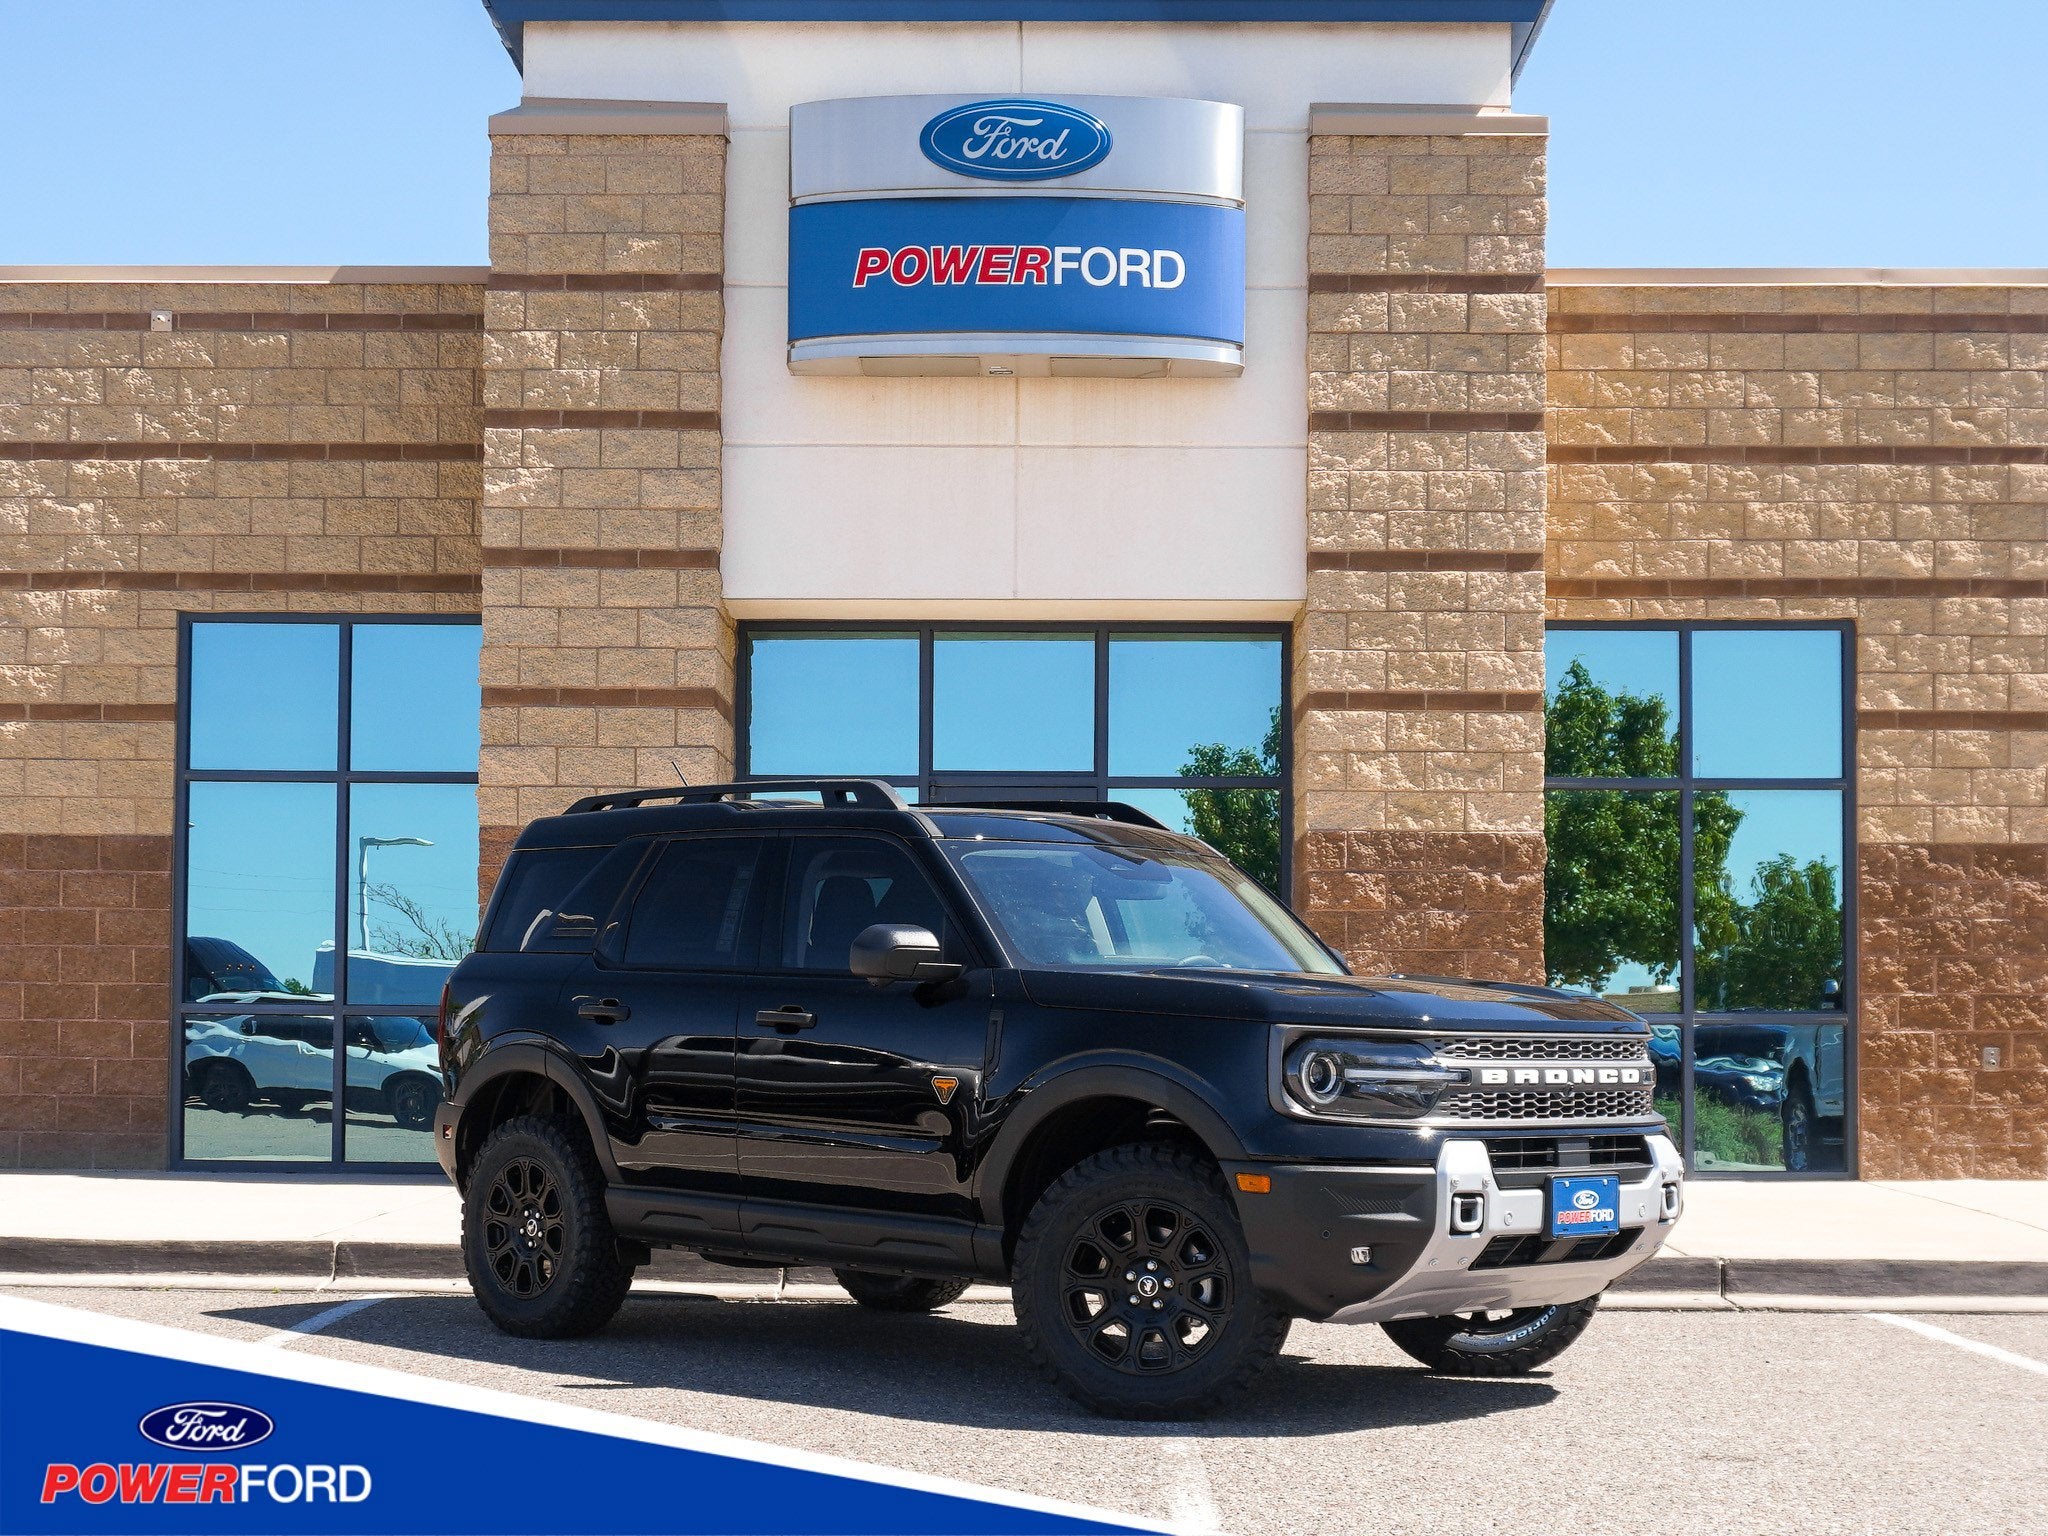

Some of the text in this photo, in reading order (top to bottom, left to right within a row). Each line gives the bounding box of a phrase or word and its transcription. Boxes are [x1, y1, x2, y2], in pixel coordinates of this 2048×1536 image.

[962, 115, 1070, 161] Ford
[852, 244, 1187, 290] POWERFORD
[1481, 1068, 1640, 1085] BRONCO
[1557, 1208, 1615, 1225] POWERFORD
[1505, 1304, 1558, 1343] odrich
